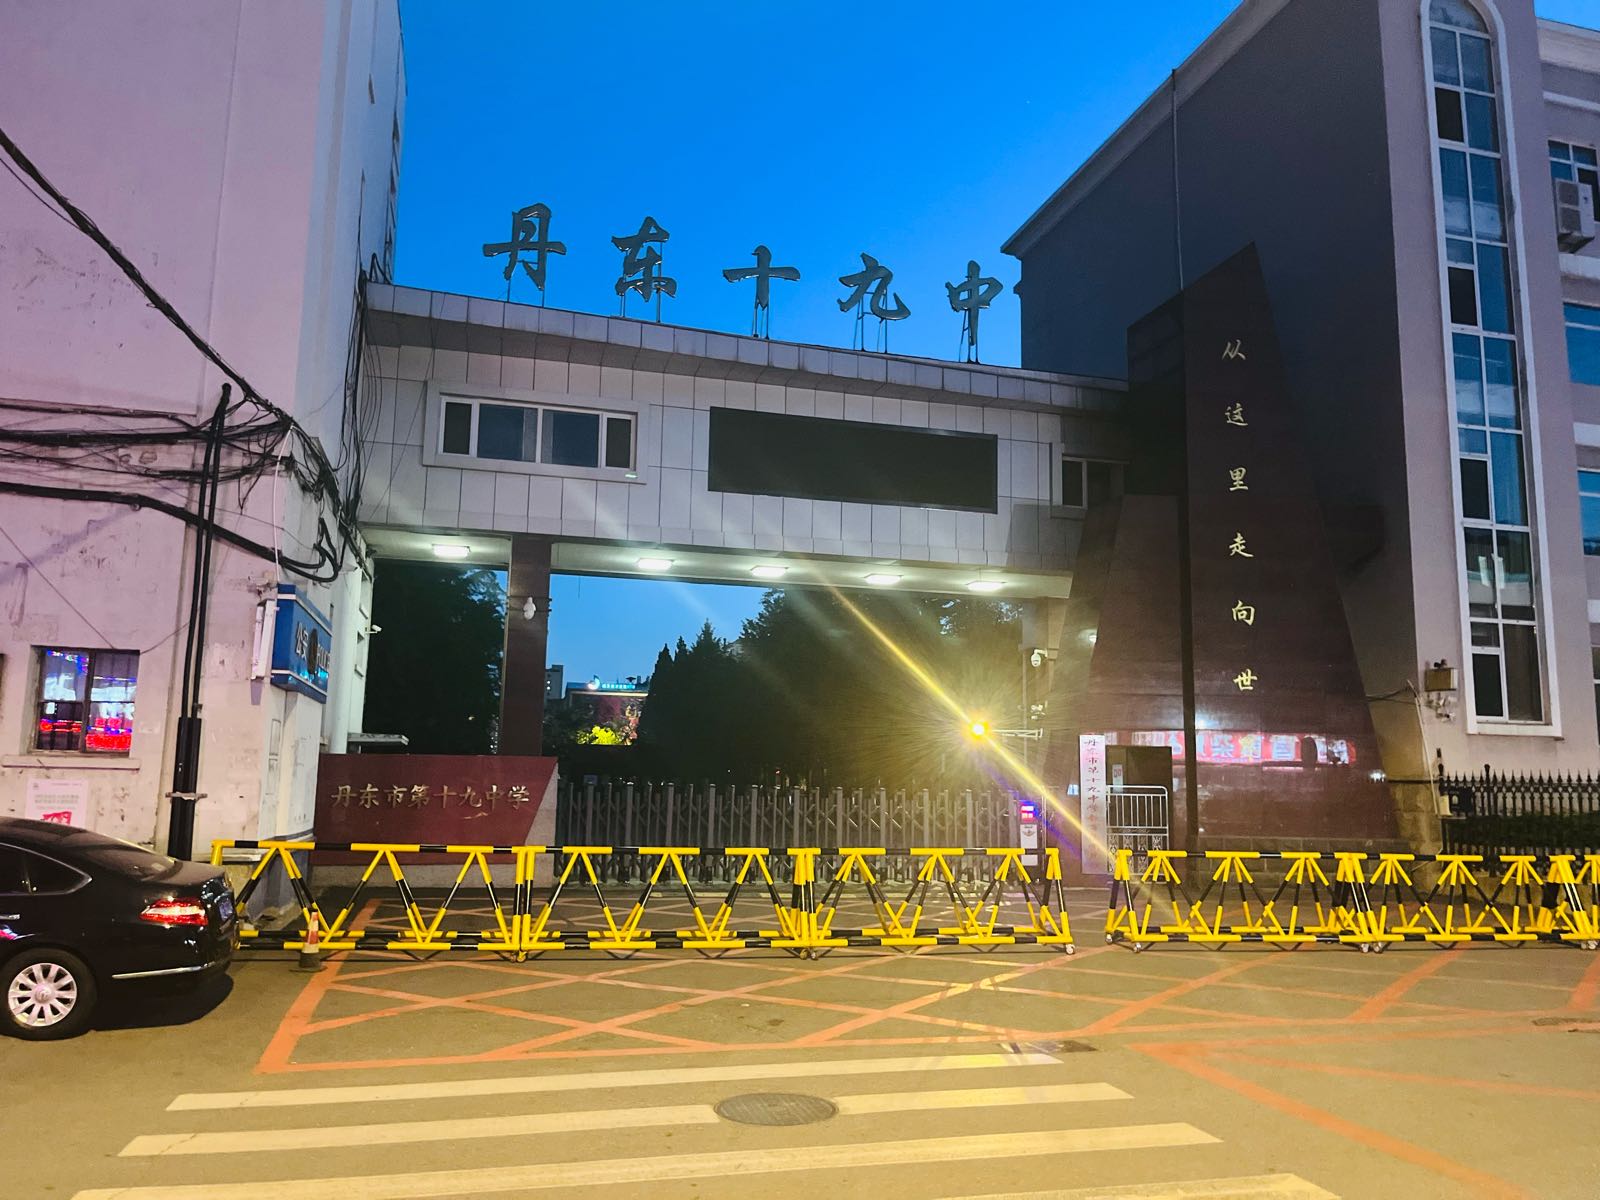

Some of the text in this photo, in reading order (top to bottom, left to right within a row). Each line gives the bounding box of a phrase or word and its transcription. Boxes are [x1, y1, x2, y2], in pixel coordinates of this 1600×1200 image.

[483, 203, 1004, 346] 丹东十九中
[1221, 339, 1258, 691] 从这里走向世
[331, 783, 530, 810] 丹东市第十九中学
